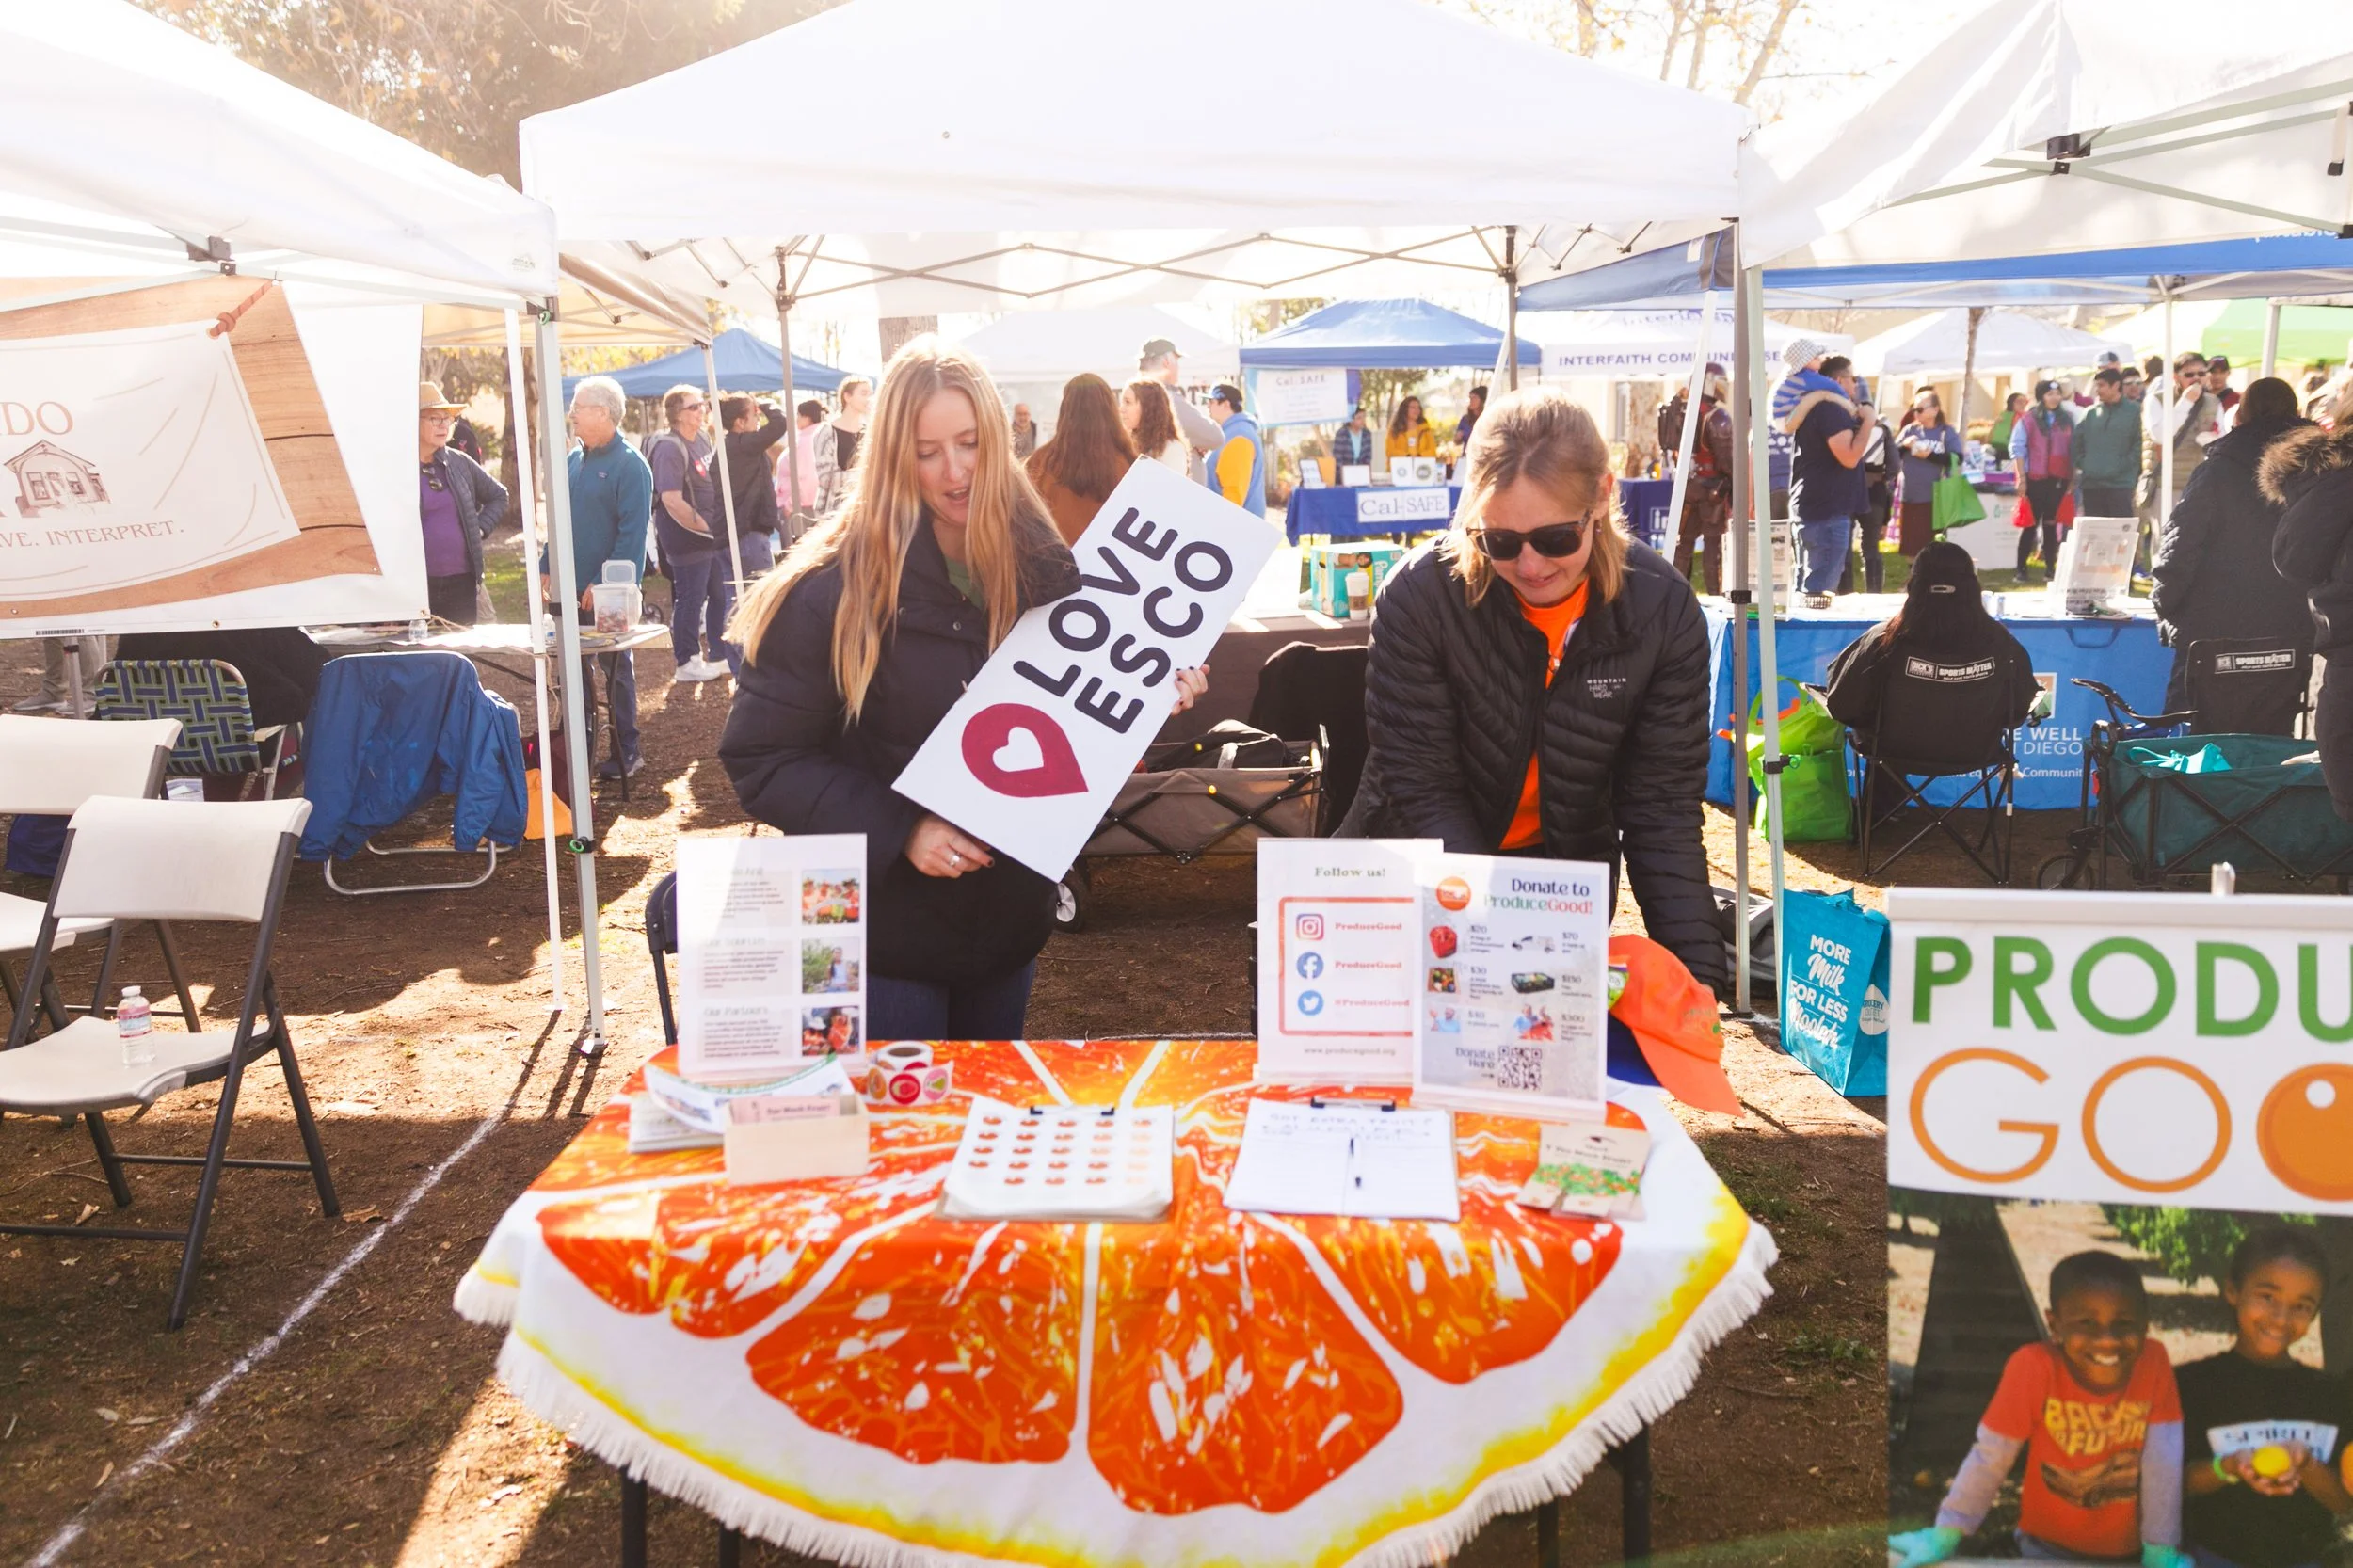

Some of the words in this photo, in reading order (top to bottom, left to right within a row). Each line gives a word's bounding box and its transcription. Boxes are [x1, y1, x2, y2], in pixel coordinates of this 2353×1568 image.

[1559, 353, 1652, 366] INTERFAITH
[45, 520, 184, 547] INTERPRET.
[1013, 507, 1178, 697] LOVE
[1074, 540, 1233, 734] ESCO
[2030, 727, 2082, 741] WELL
[2024, 741, 2083, 755] DIEGO
[1315, 867, 1362, 878] Follow
[1367, 868, 1386, 878] us!
[1511, 877, 1569, 896] Donate
[1573, 882, 1590, 897] to
[1809, 934, 1851, 966] MORE
[1807, 952, 1845, 997] Milk
[1790, 979, 1817, 1006] FOR
[1817, 994, 1849, 1023] LESS
[1913, 936, 2353, 1042] PRODU
[1455, 1047, 1495, 1059] Donate
